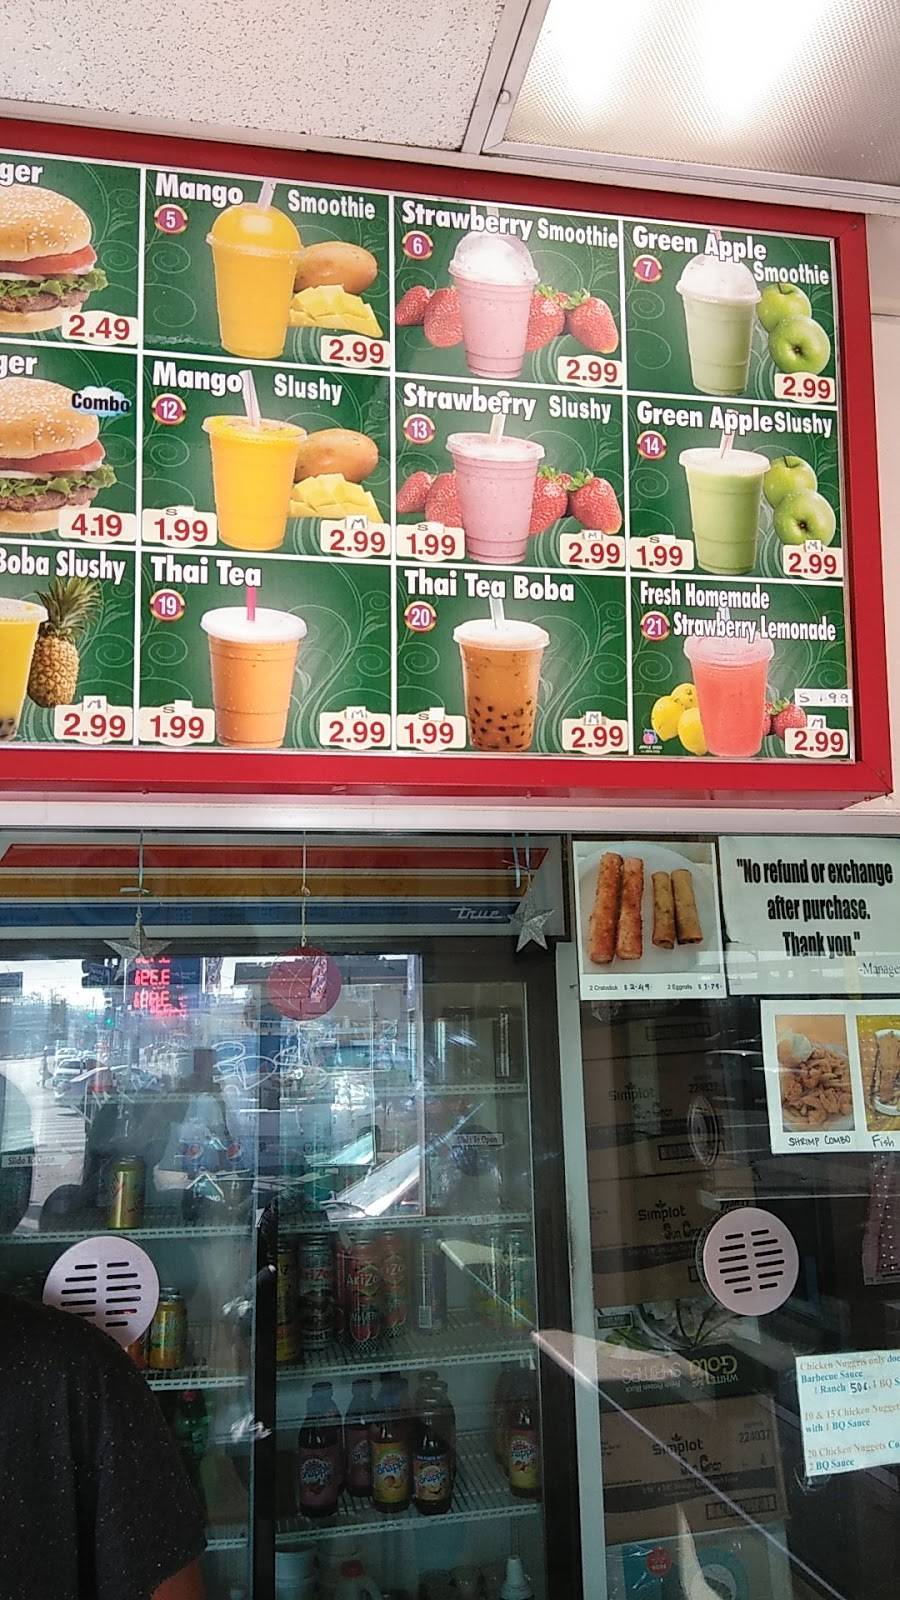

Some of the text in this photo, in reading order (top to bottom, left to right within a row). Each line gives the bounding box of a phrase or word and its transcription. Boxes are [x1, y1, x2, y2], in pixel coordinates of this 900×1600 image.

[155, 173, 376, 219] Mango Smoothie
[165, 210, 177, 229] 5
[402, 200, 619, 248] Strawberry Smoothie
[412, 237, 424, 255] 6
[633, 226, 767, 263] Green Apple
[642, 261, 652, 277] 7
[753, 261, 830, 285] Smoothie
[69, 314, 130, 341] 2.49
[329, 338, 385, 364] 2.99
[566, 358, 619, 384] 2.99
[153, 361, 344, 406] Mango Slushy
[783, 375, 831, 400] 2.99
[71, 392, 130, 413] Combo
[160, 400, 178, 421] 12
[403, 382, 612, 424] Strawberry Slushy
[411, 420, 428, 440] 13
[636, 401, 833, 438] Green Apple Slushy
[644, 437, 660, 455] 14
[165, 507, 178, 517] S
[71, 513, 123, 538] 4.19
[154, 518, 209, 544] 1.99
[417, 523, 429, 533] S
[329, 529, 386, 555] 2.99
[406, 533, 456, 557] 1.99
[649, 536, 660, 544] S
[568, 541, 621, 564] 2.99
[636, 546, 684, 567] 1.99
[788, 552, 837, 575] 2.99
[55, 549, 126, 586] Slushy
[150, 555, 262, 588] Thai Tea
[404, 568, 575, 601] Thai Tea Boba
[640, 580, 770, 609] Fresh Homemade
[158, 596, 178, 616] 19
[411, 607, 430, 627] 20
[646, 617, 662, 636] 21
[673, 611, 837, 643] Strawberry Lemonade
[162, 705, 176, 714] S
[418, 713, 429, 721] S
[63, 713, 126, 739] 2.99
[150, 715, 205, 739] 1.99
[329, 720, 386, 744] 2.99
[403, 722, 454, 745] 1.99
[571, 726, 623, 749] 2.99
[794, 731, 845, 753] 2.99
[764, 859, 809, 884] refund
[811, 864, 826, 883] or
[828, 861, 893, 887] exchange
[767, 895, 871, 923] after purchase.
[782, 931, 861, 960] Thank you."
[788, 1135, 852, 1147] SHRIMP COMBO
[872, 1134, 895, 1148] Fish
[638, 1206, 687, 1223] Simplot
[801, 1370, 864, 1383] Barbecue Sauce
[820, 1383, 846, 1394] Ranch
[805, 1423, 823, 1433] with
[832, 1421, 845, 1431] BQ
[847, 1419, 871, 1429] Sauce
[816, 1461, 829, 1471] BQ
[831, 1459, 856, 1469] Sauce
